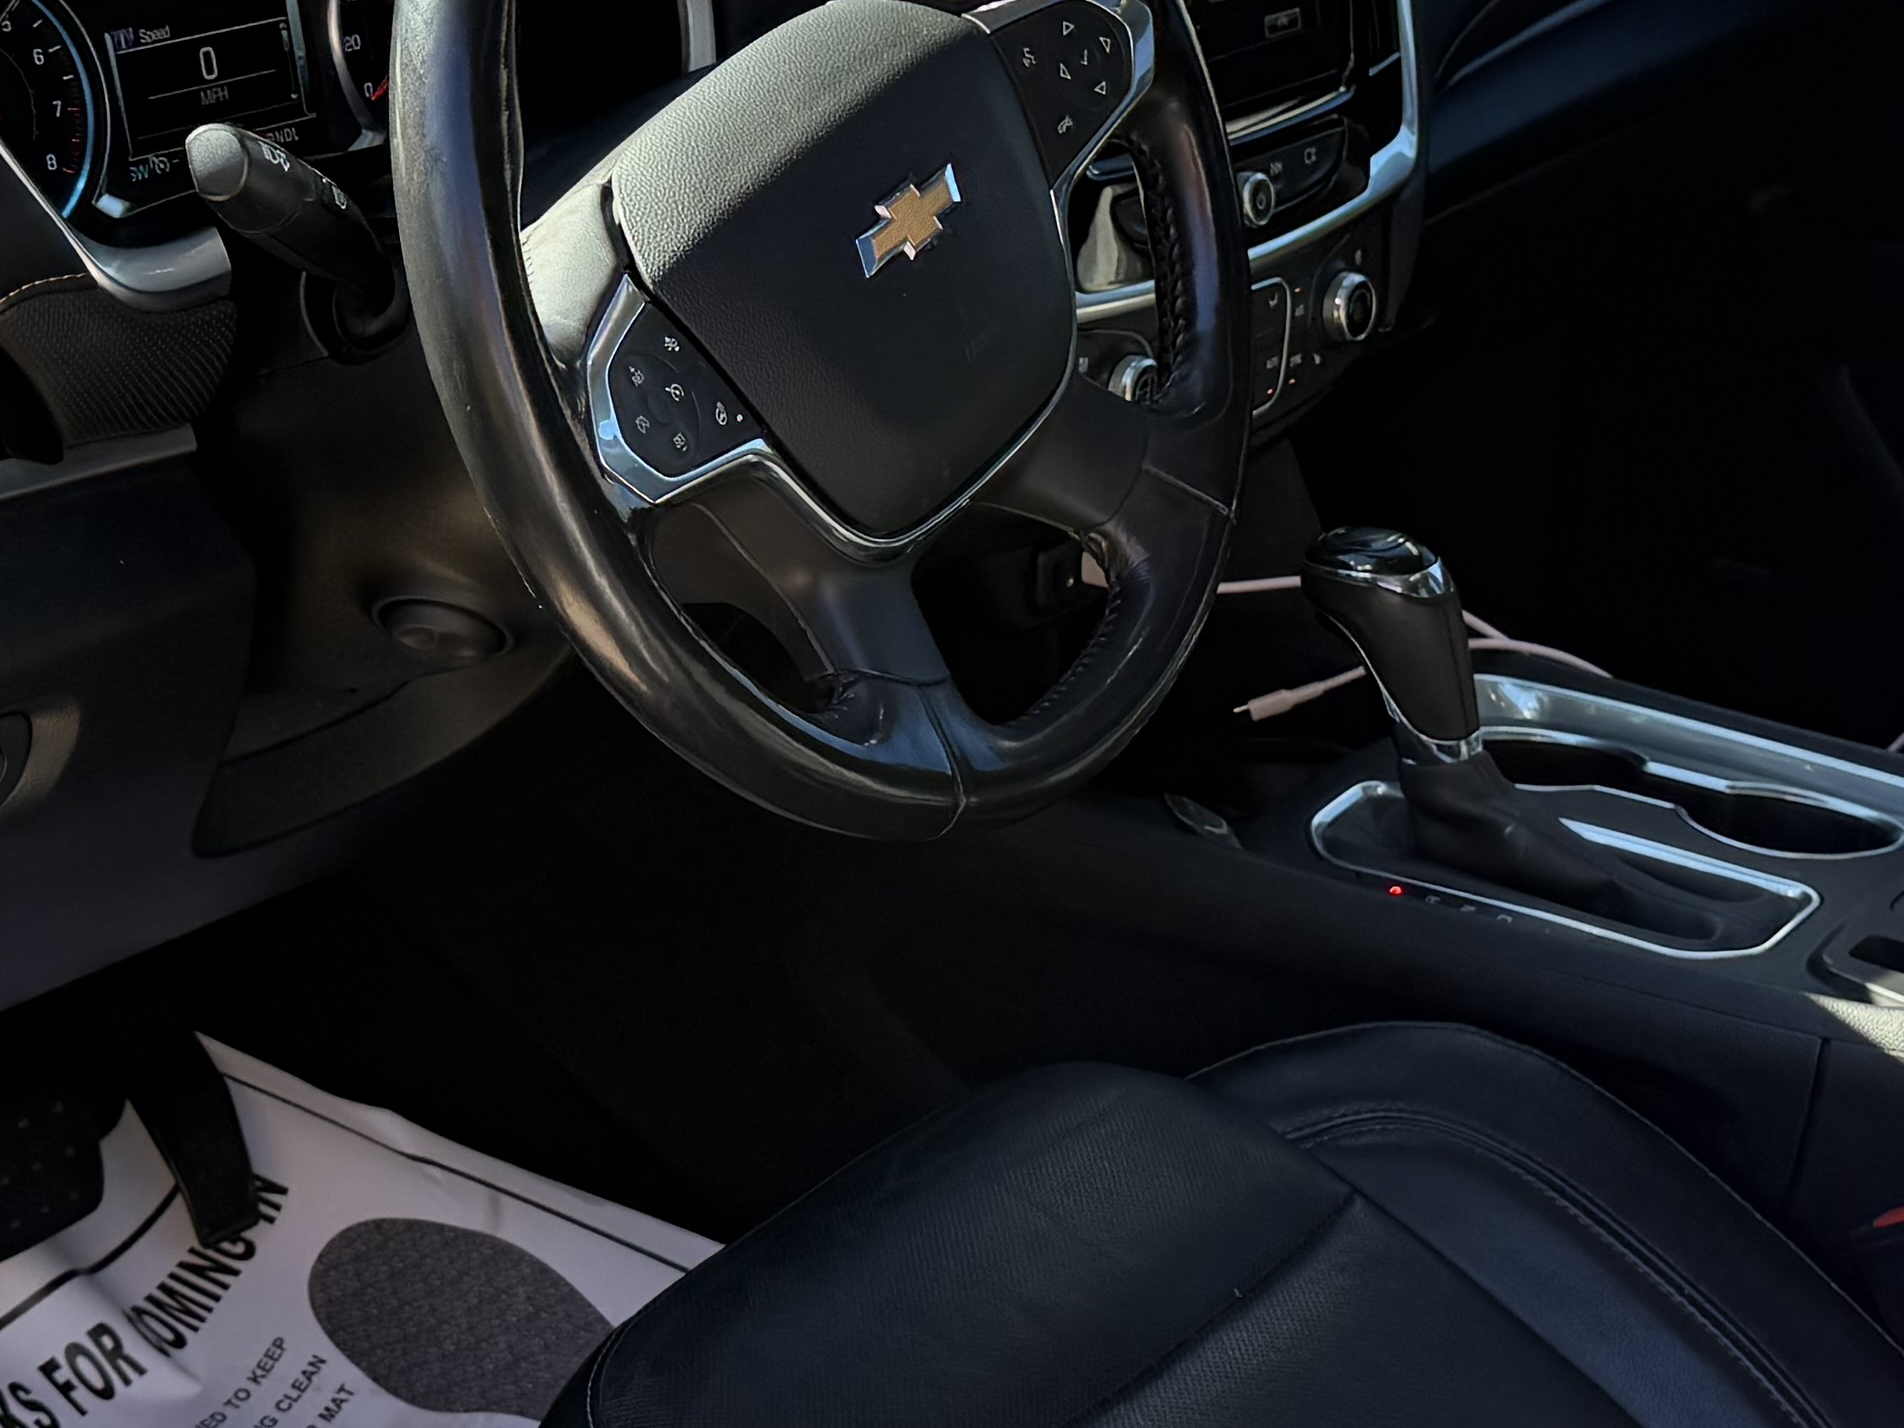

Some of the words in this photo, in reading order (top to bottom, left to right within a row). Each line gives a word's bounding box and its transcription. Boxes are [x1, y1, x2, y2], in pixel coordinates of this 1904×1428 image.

[343, 34, 361, 52] 20
[33, 49, 45, 65] 6
[199, 46, 219, 80] 0
[200, 86, 230, 106] MPH
[364, 82, 374, 98] 0
[52, 100, 62, 118] 7
[46, 154, 57, 170] 8
[37, 1322, 148, 1418] FOR
[223, 1387, 252, 1410] TO
[247, 1336, 287, 1385] KEEP
[275, 1354, 327, 1413] CLEAN
[318, 1384, 355, 1424] MAT
